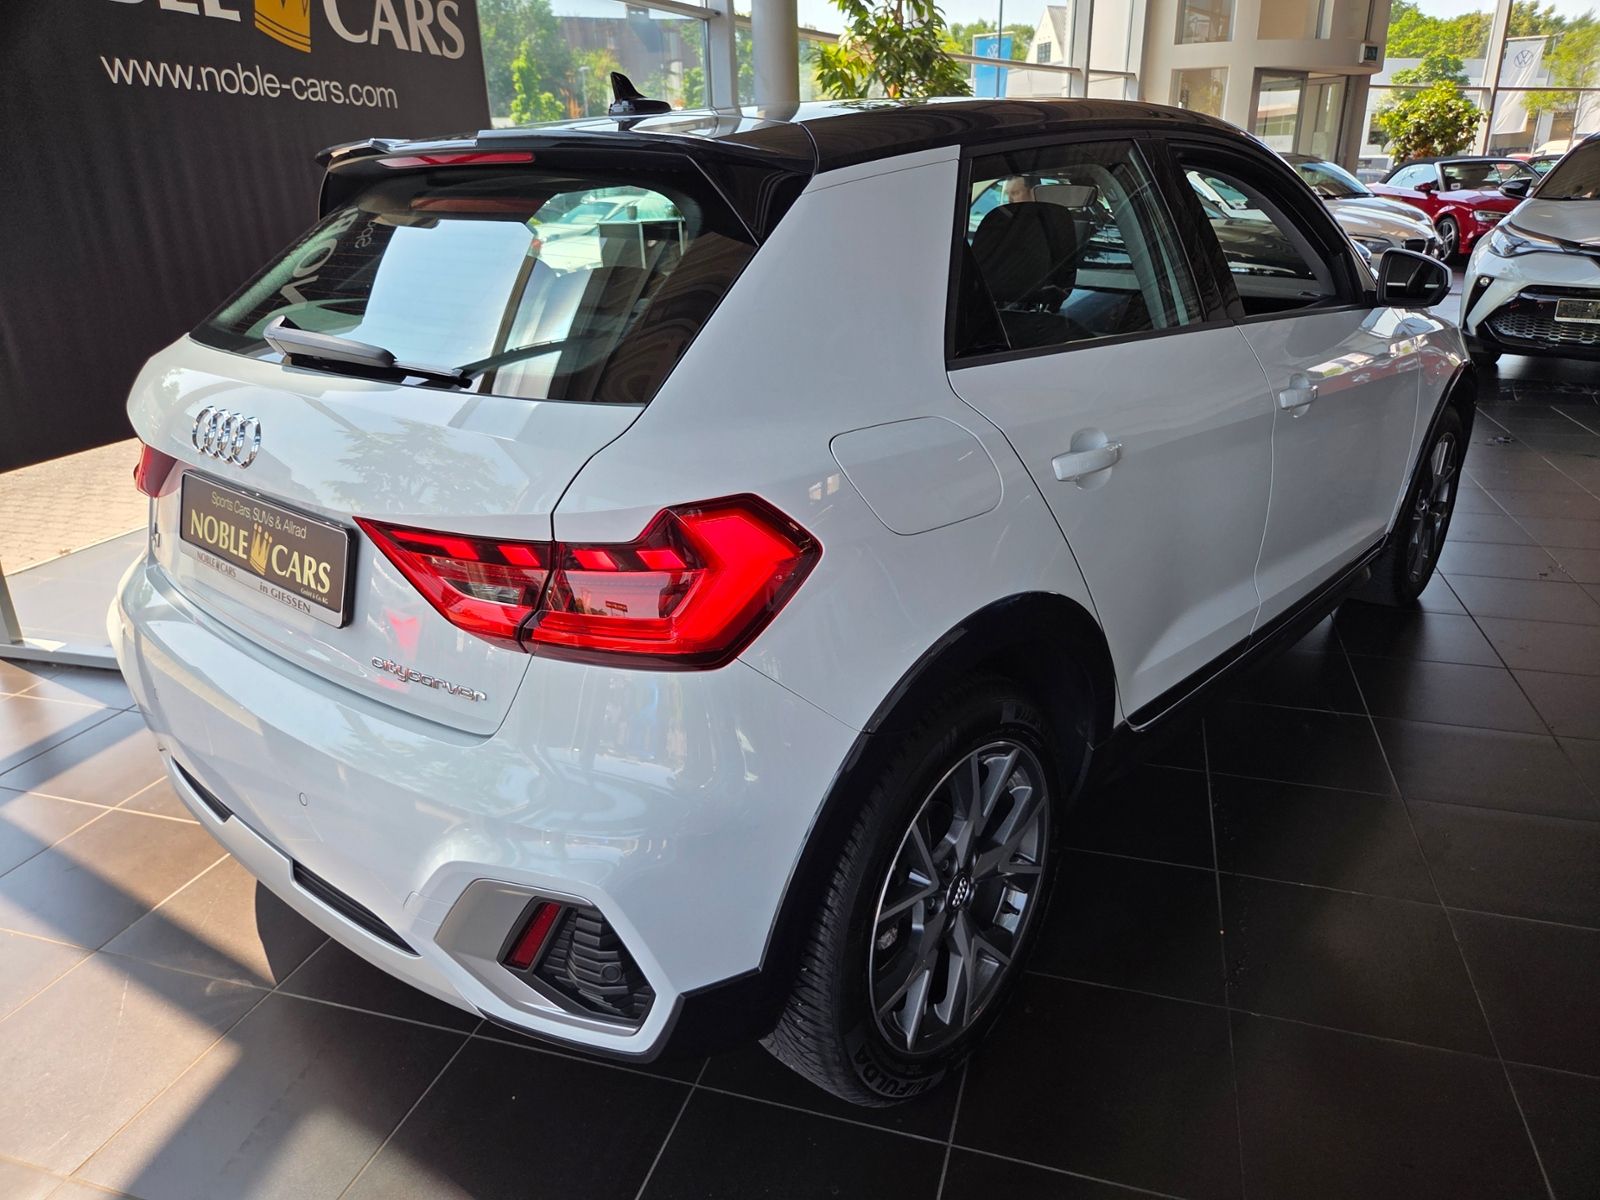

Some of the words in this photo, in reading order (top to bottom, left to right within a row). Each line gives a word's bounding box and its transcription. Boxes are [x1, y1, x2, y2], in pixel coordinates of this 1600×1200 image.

[323, 0, 466, 60] CARS
[100, 55, 399, 109] www.noble-cars.com
[211, 490, 234, 514] Sports
[275, 516, 282, 531] &
[283, 518, 307, 540] Allrad
[190, 509, 249, 560] NOBLE
[271, 544, 332, 594] CARS
[259, 581, 269, 595] in
[270, 587, 312, 614] GIESSEN
[371, 656, 488, 702] citycarver
